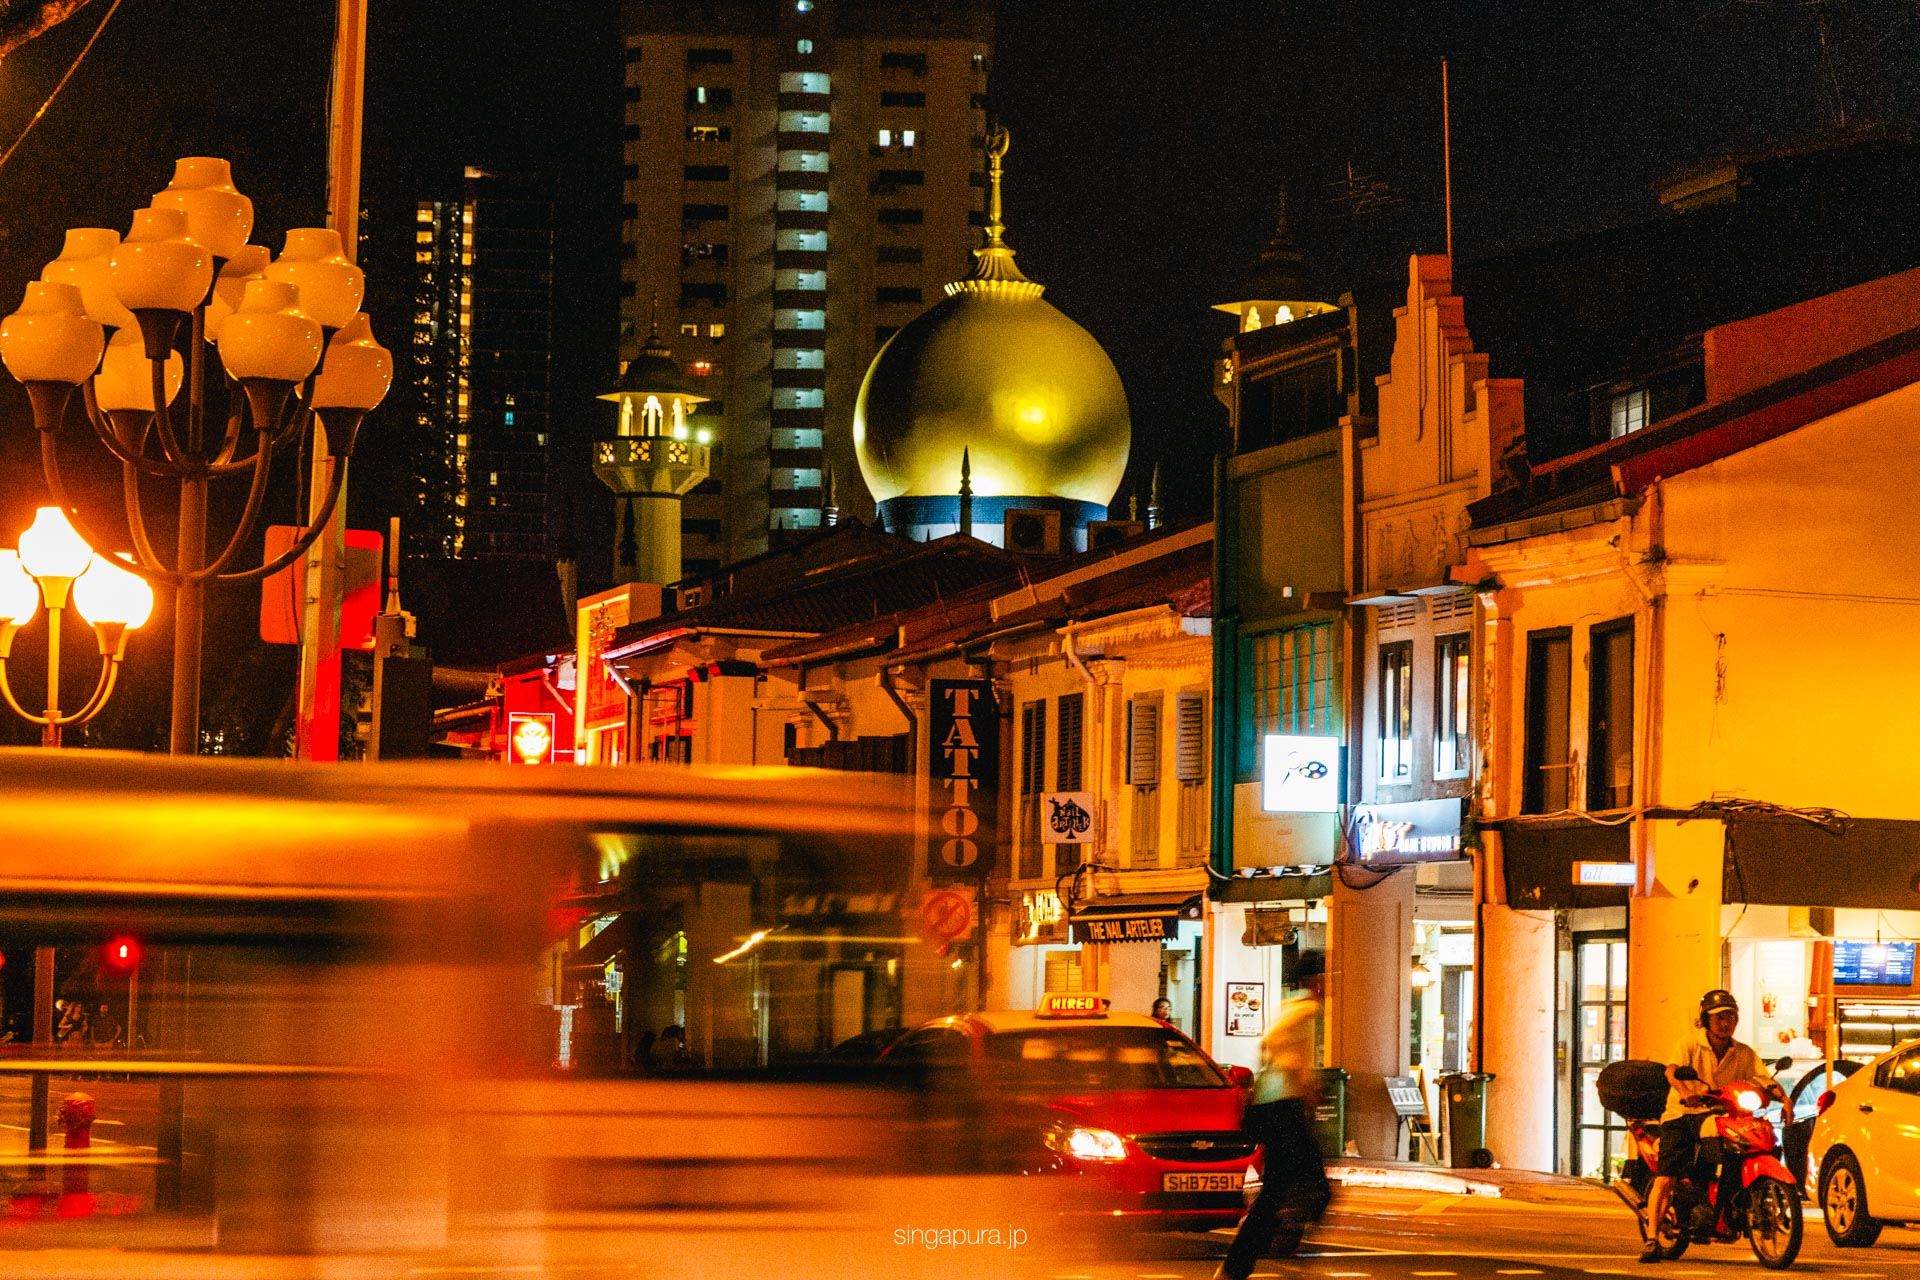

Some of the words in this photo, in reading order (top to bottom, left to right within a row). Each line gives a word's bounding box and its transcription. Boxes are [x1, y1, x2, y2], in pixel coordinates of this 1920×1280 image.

[941, 689, 979, 867] TATTOO
[1088, 921, 1105, 939] THE
[1105, 920, 1125, 939] NAIL
[1126, 918, 1165, 937] ARTELIER
[1051, 997, 1095, 1010] HIRED
